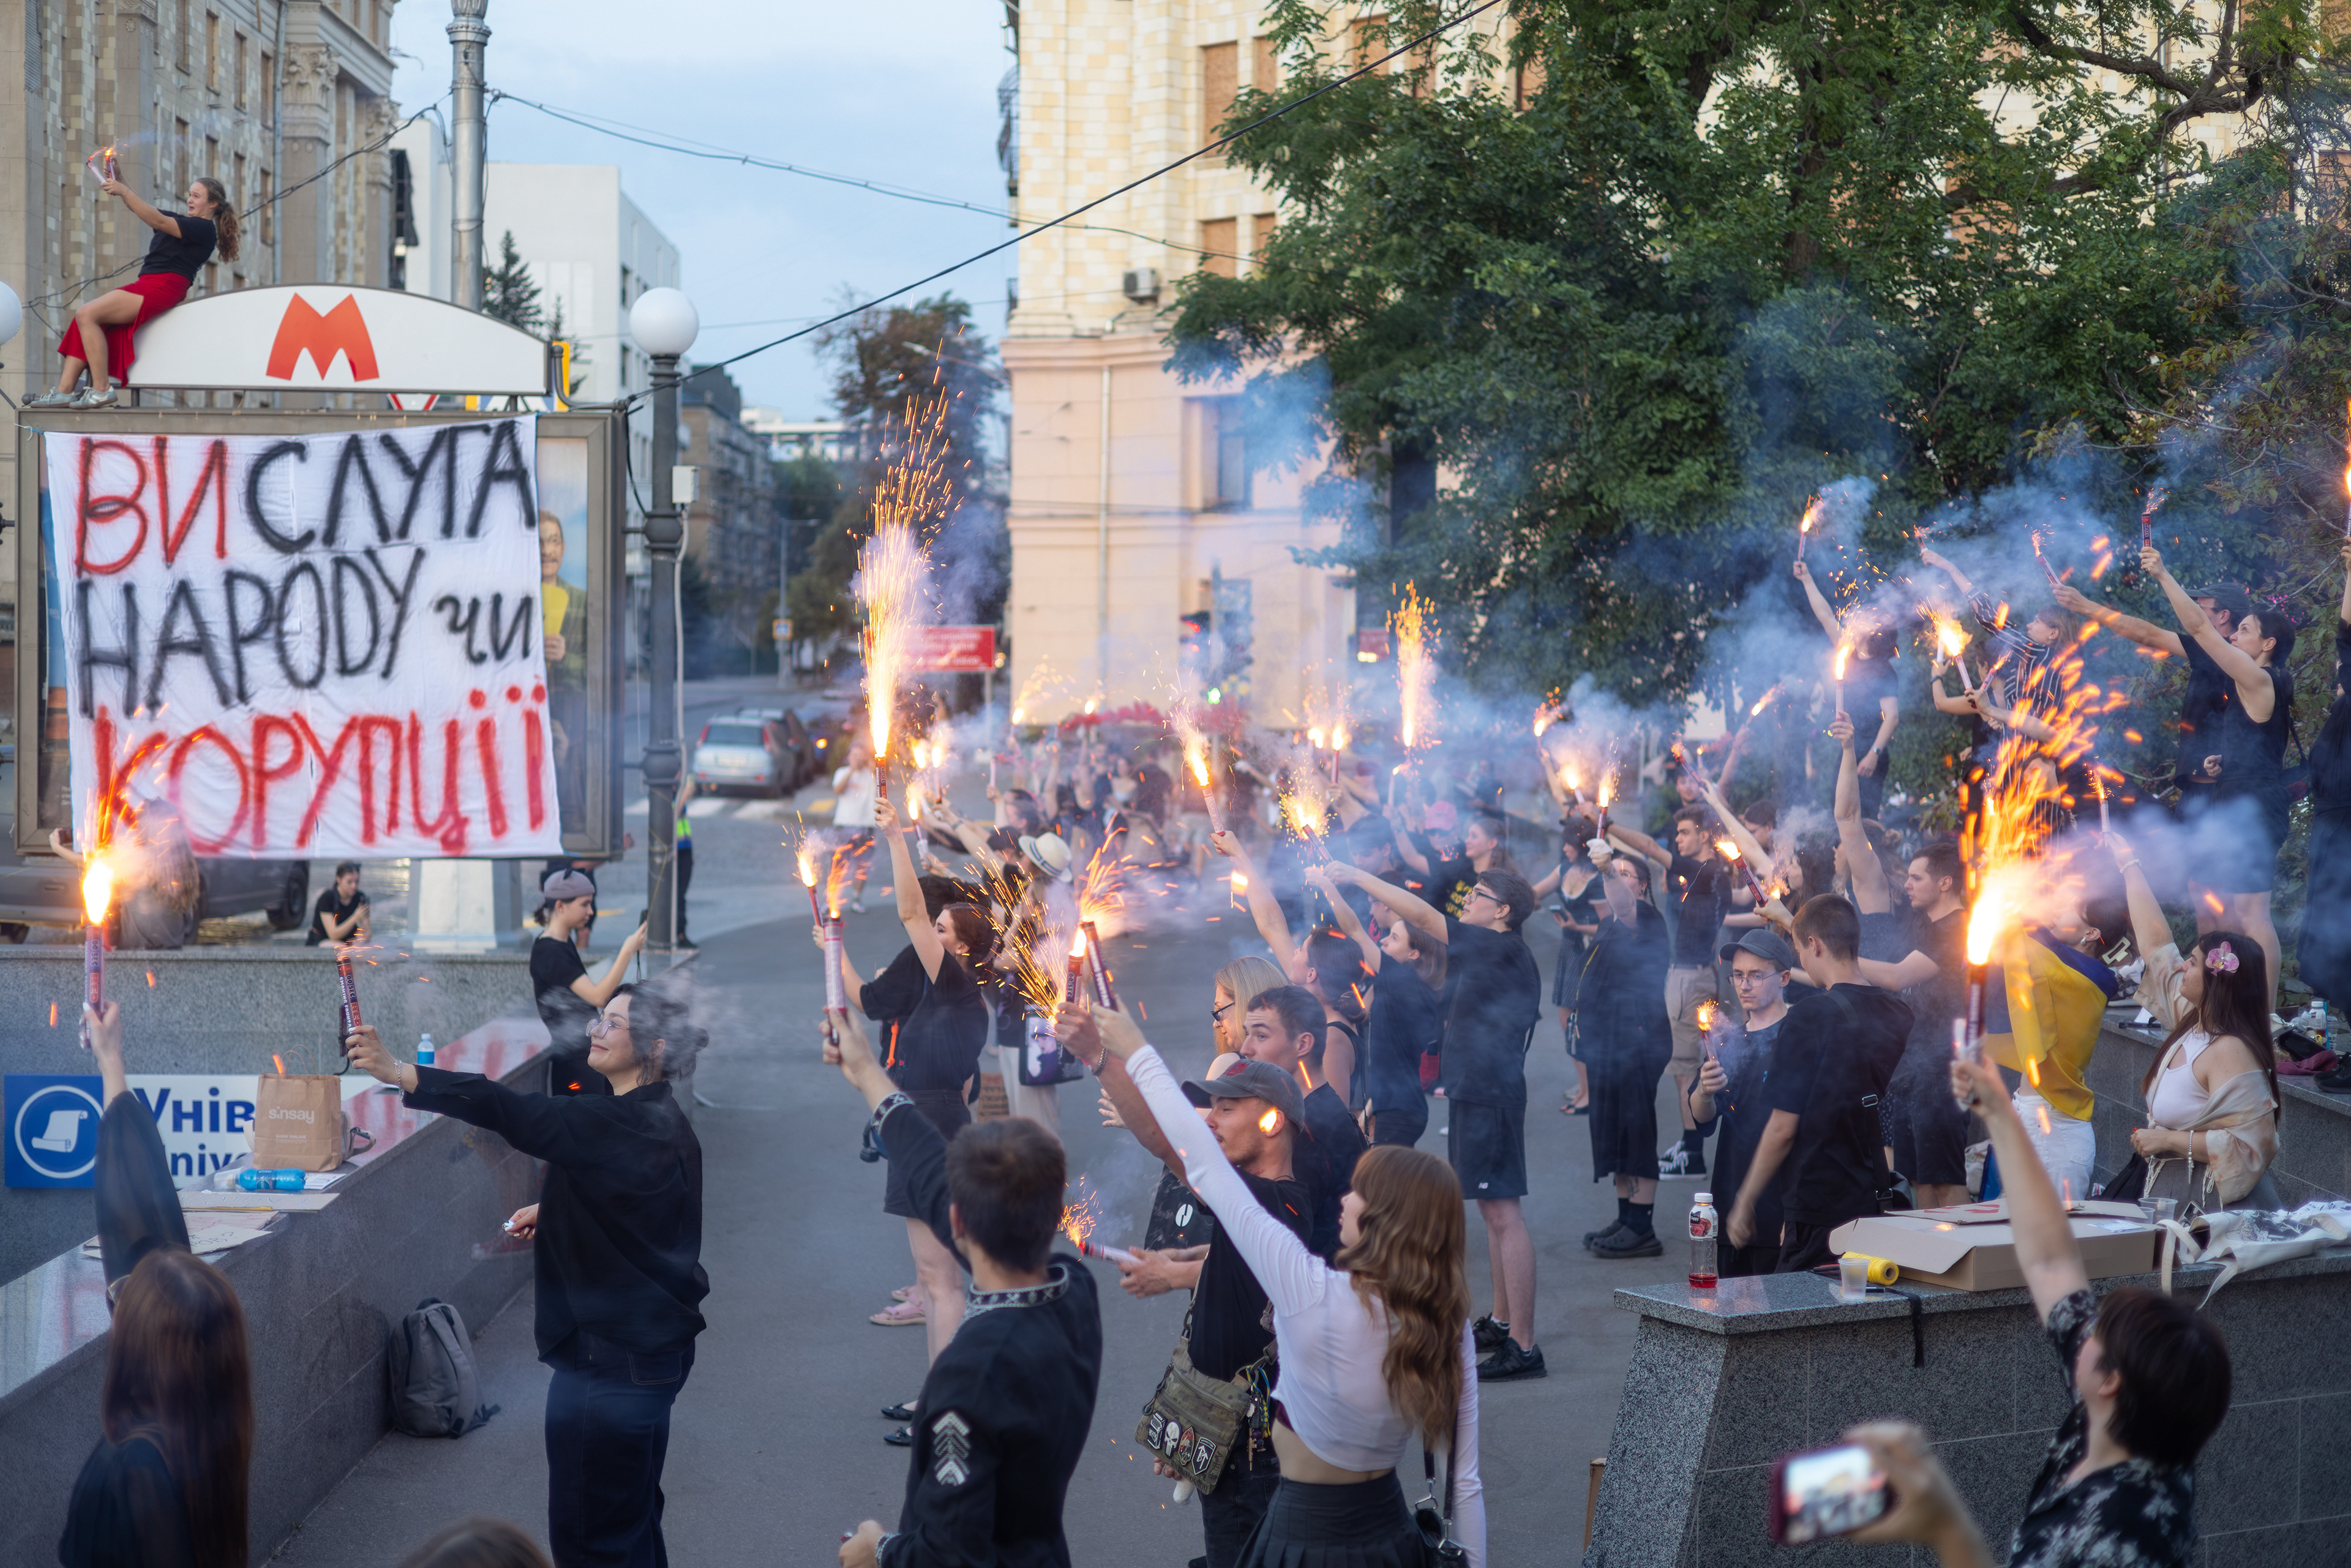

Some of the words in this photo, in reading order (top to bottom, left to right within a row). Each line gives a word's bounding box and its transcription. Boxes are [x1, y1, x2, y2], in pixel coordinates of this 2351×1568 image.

[74, 436, 229, 578] ВИ
[247, 420, 536, 553] СЛУГА
[433, 591, 534, 665] чи
[339, 977, 347, 1003] SMOKING
[343, 1004, 352, 1028] FOUNTA
[350, 1002, 361, 1027] RED
[132, 1087, 255, 1132] Унів
[269, 1106, 315, 1124] sinsay
